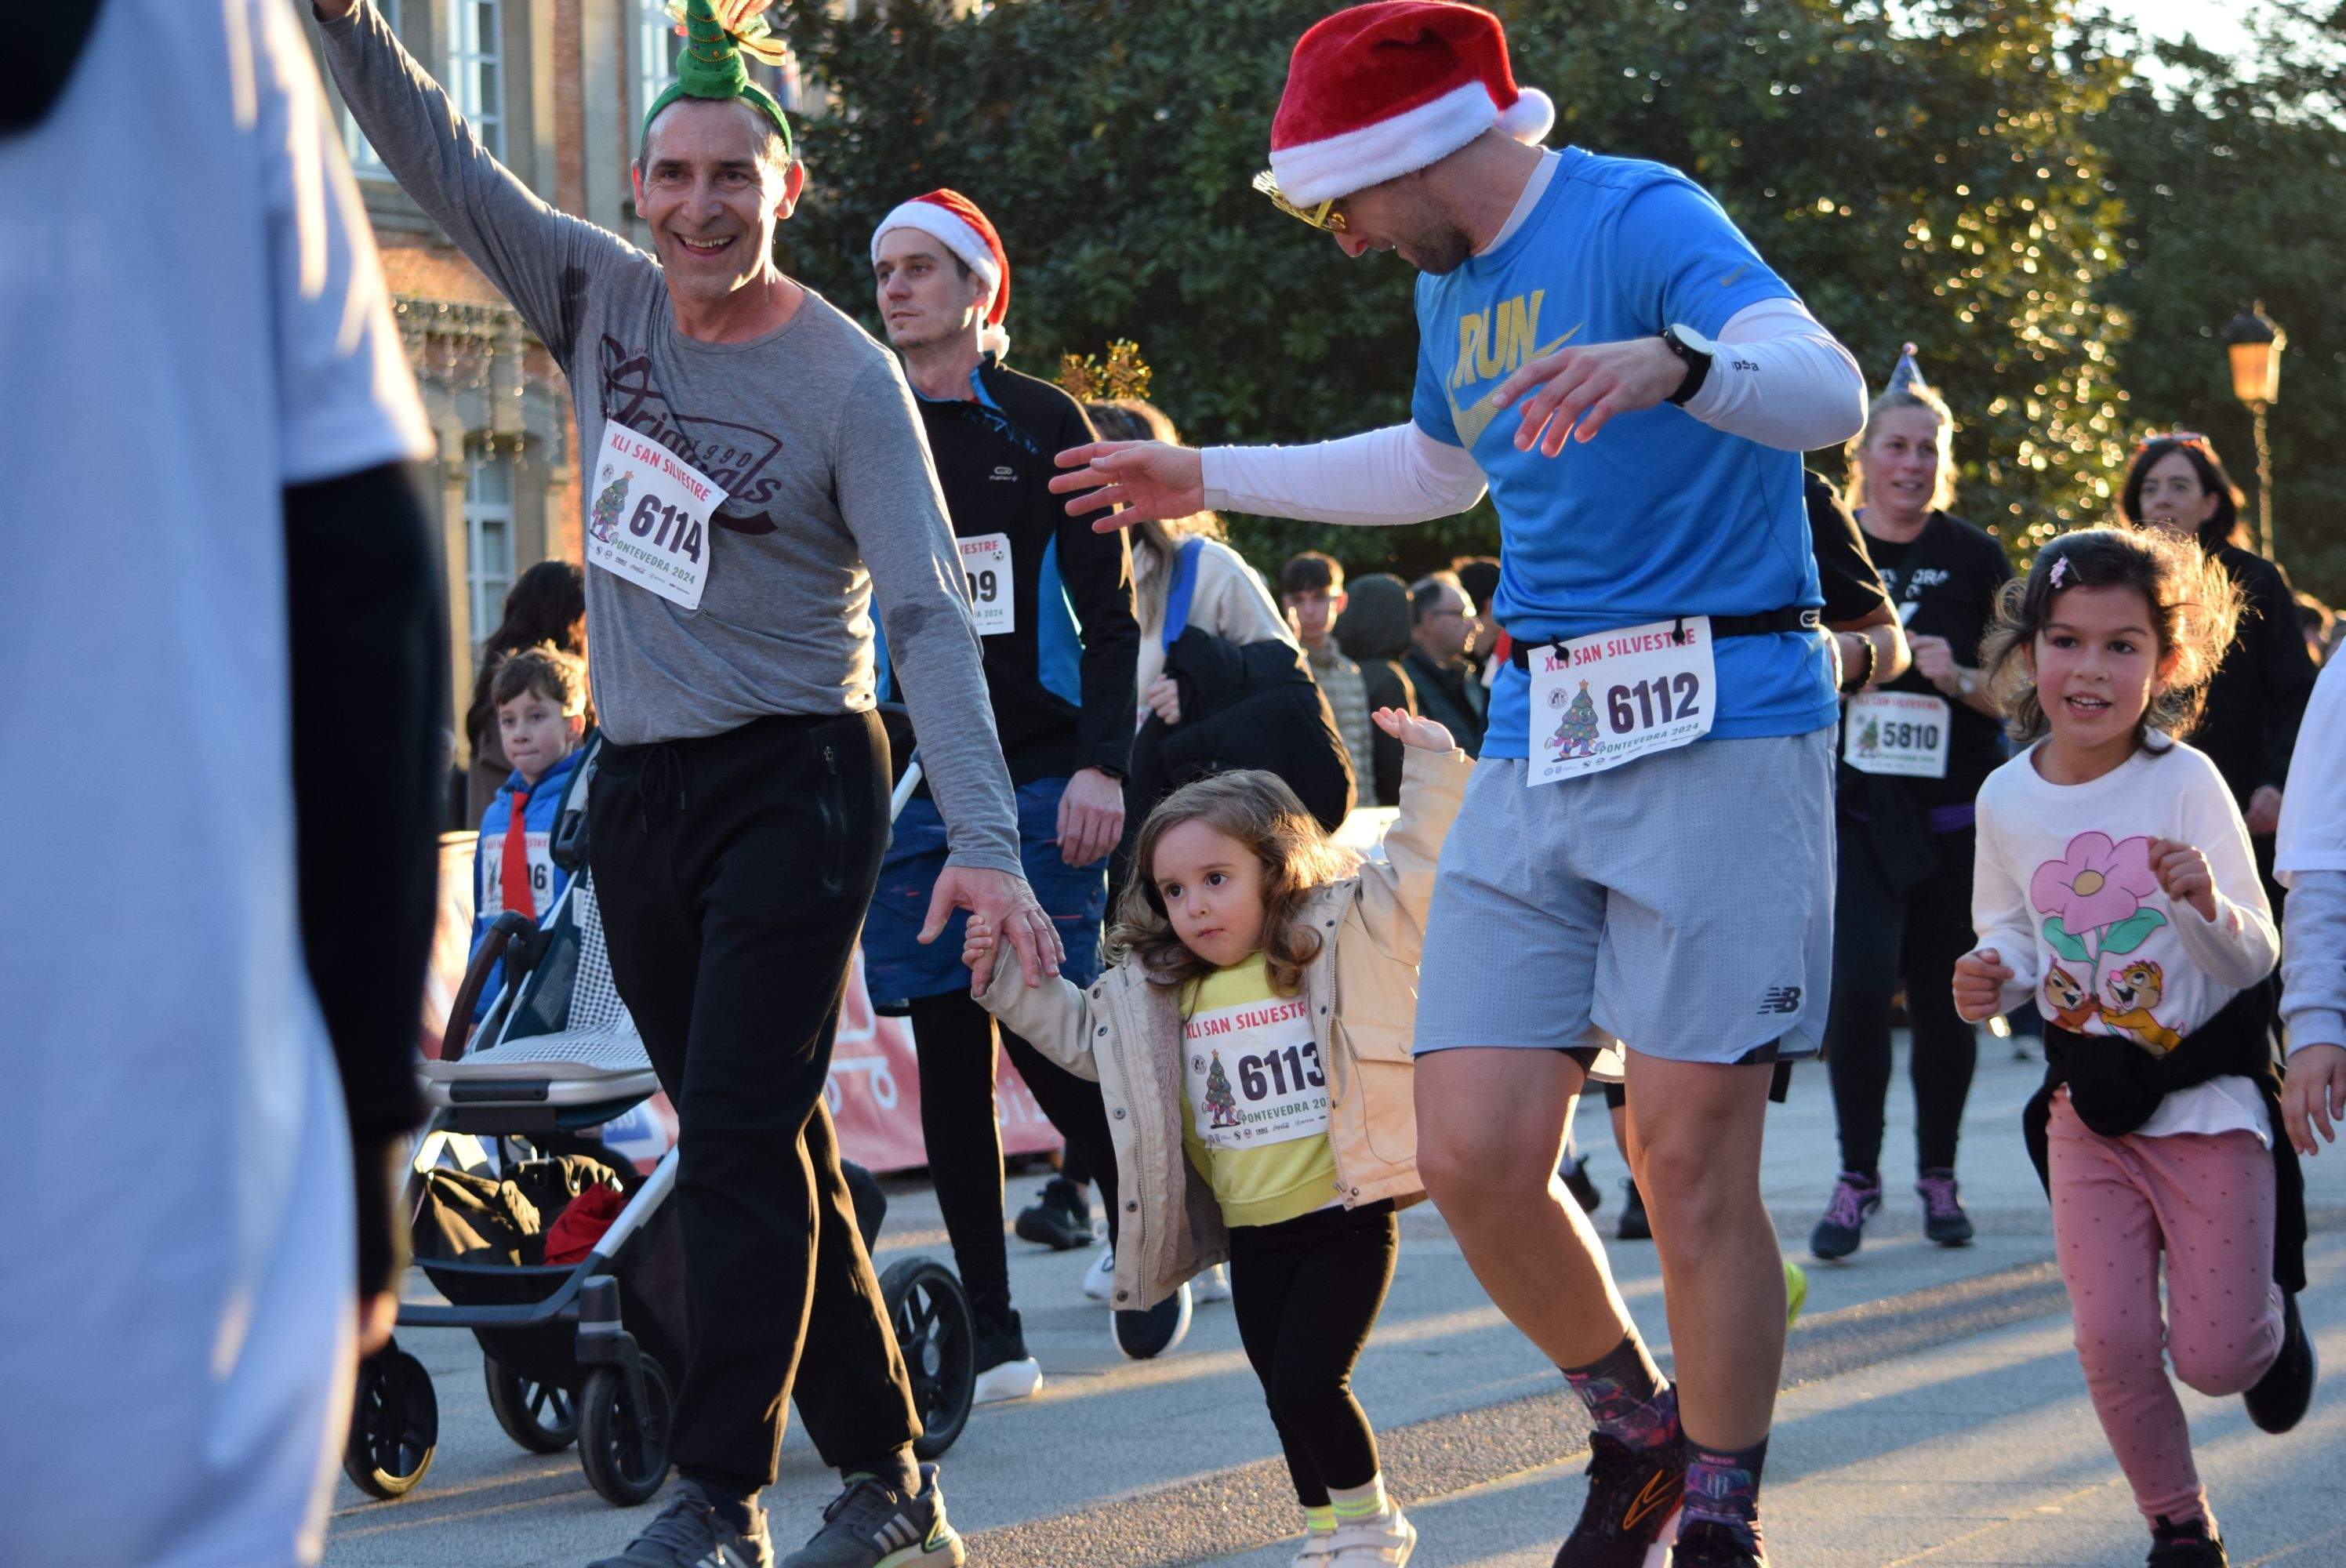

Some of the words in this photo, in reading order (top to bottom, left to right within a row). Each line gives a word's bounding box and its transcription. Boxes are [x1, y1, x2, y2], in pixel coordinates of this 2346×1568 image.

[1454, 289, 1545, 388] RUN
[611, 433, 630, 453] XLI
[633, 445, 661, 467] SAN
[663, 458, 712, 503] SILVESTRE
[629, 494, 703, 564] 6114
[611, 538, 670, 573] PONTEVEDRA
[671, 566, 696, 585] 2024
[1573, 644, 1603, 667] SAN
[1607, 628, 1696, 658] SILVESTE
[1607, 672, 1700, 735] 6112
[1600, 731, 1668, 755] PONTEVEDRA
[1671, 722, 1700, 736] 2024
[1883, 722, 1938, 750] 5810
[1185, 1022, 1202, 1040] XLI
[1204, 1017, 1232, 1038] SAN
[1236, 1001, 1306, 1031] SILVESTR
[1238, 1041, 1326, 1102] 6113
[1240, 1101, 1310, 1125] PONTEVEDRA
[1312, 1098, 1327, 1109] 20
